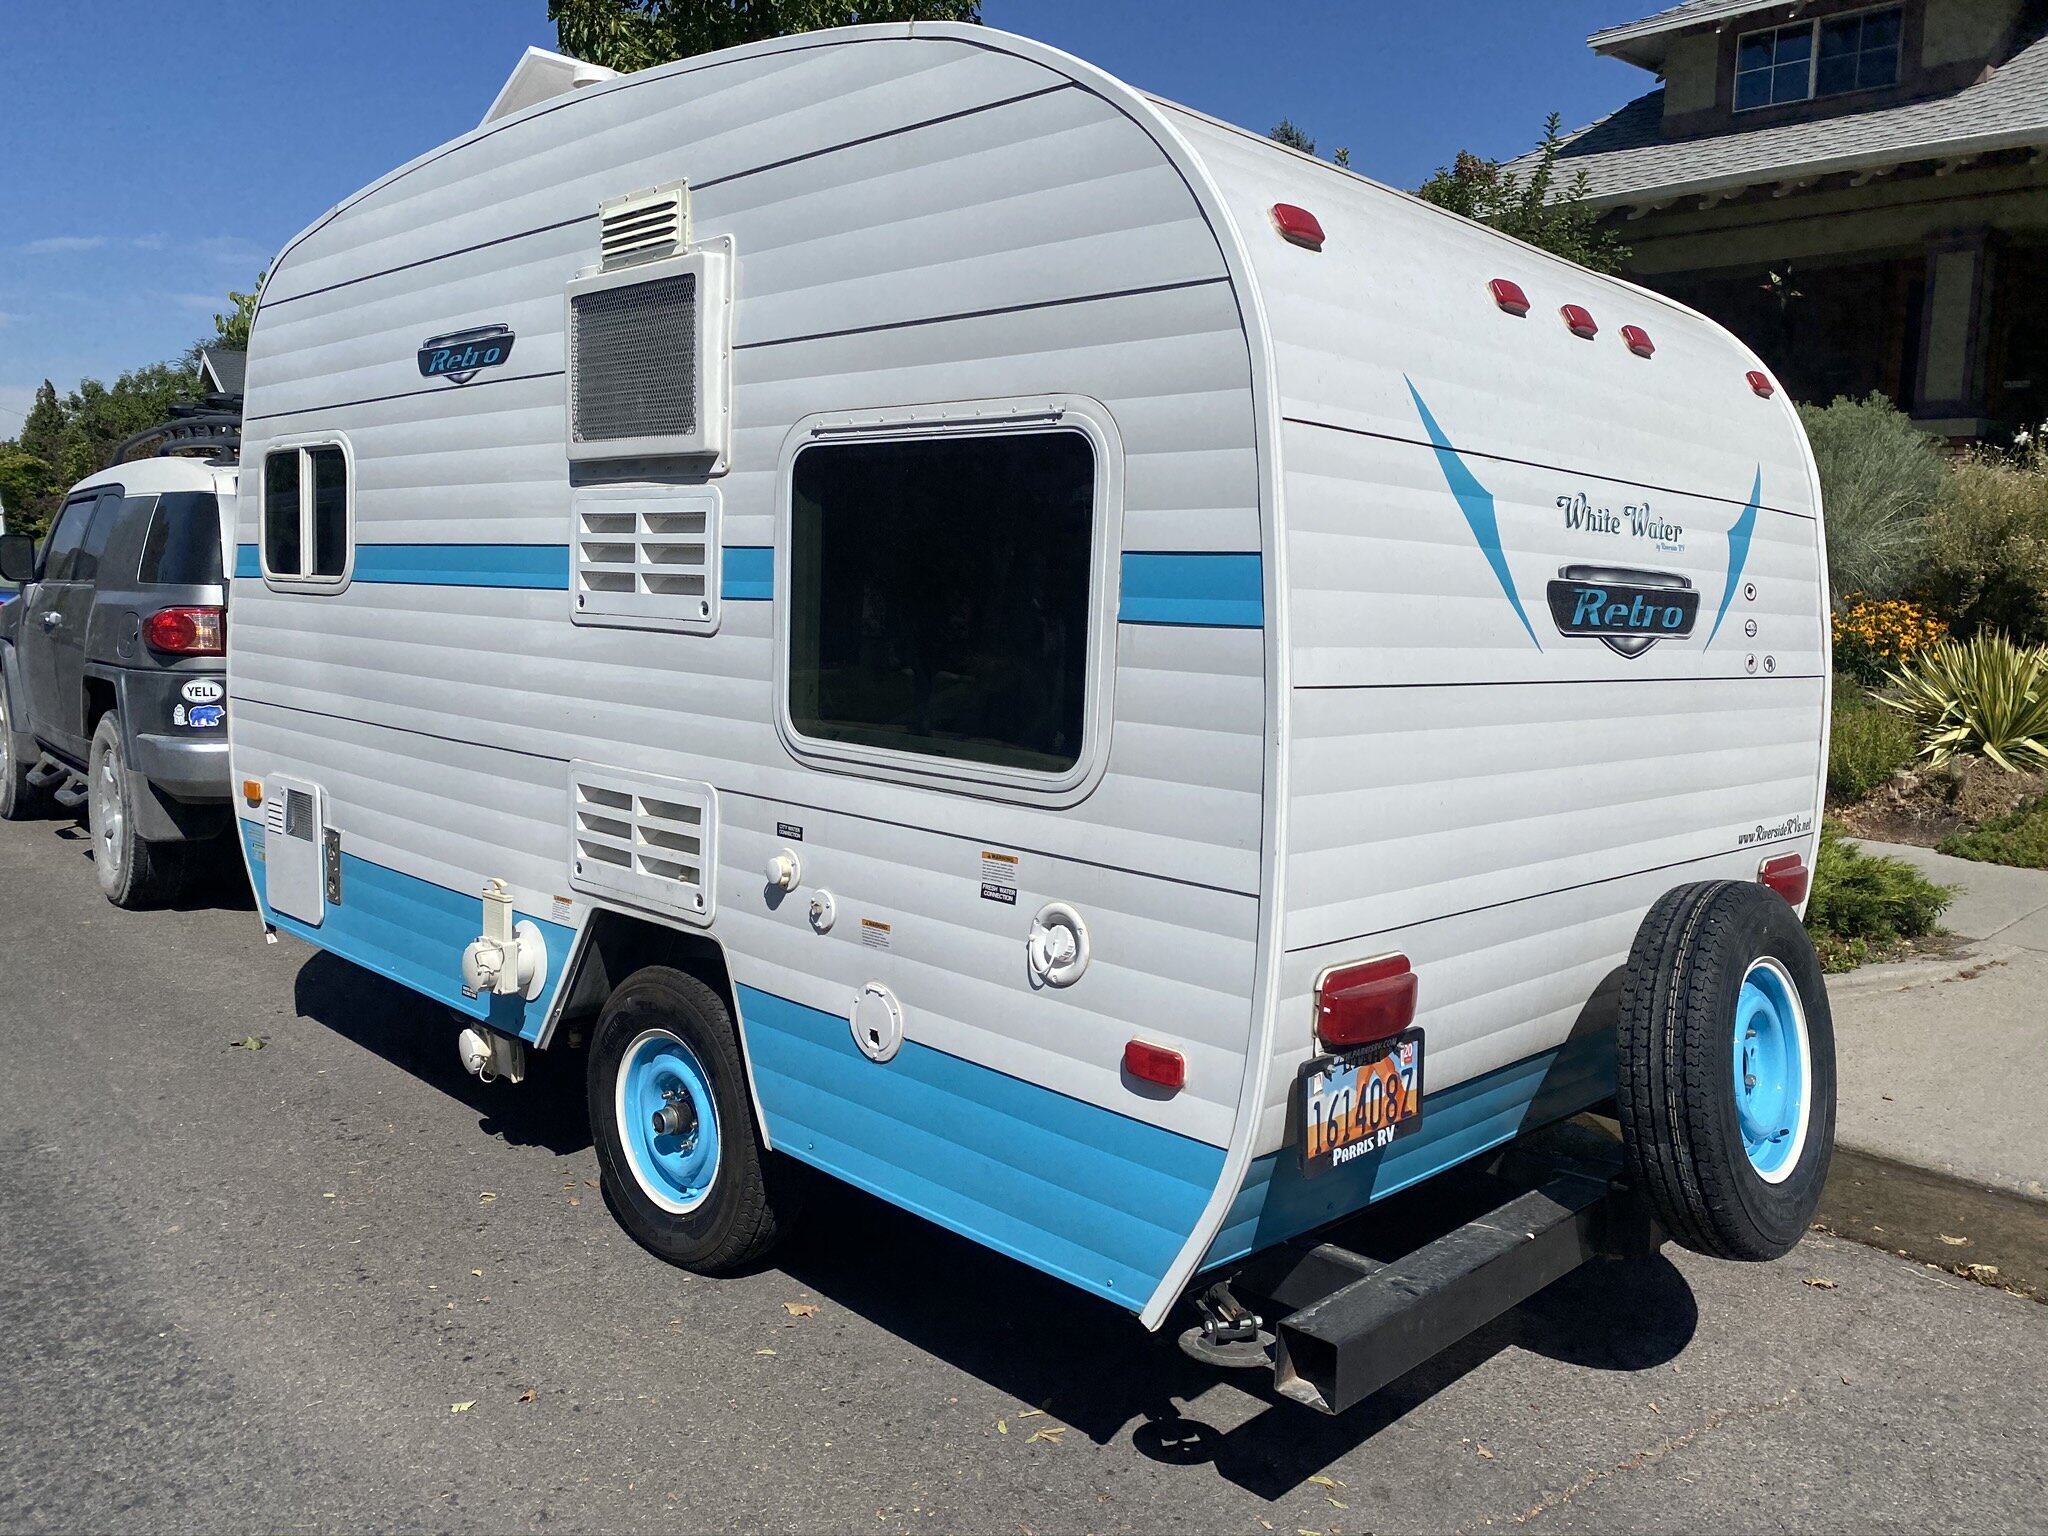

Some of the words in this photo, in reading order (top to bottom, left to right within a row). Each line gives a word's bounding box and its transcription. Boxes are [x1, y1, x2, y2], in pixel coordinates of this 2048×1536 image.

[428, 346, 501, 373] Retro
[1556, 492, 1621, 535] White
[1623, 502, 1683, 543] Water
[1571, 588, 1684, 629] Retro
[187, 686, 217, 697] YELL
[1738, 814, 1812, 845] www.RiversideRVs.net
[982, 883, 998, 892] FRESH
[999, 886, 1016, 896] WATER
[983, 890, 1014, 902] CONNECTION
[1332, 1136, 1375, 1167] PARRIS
[1377, 1124, 1396, 1147] RV
